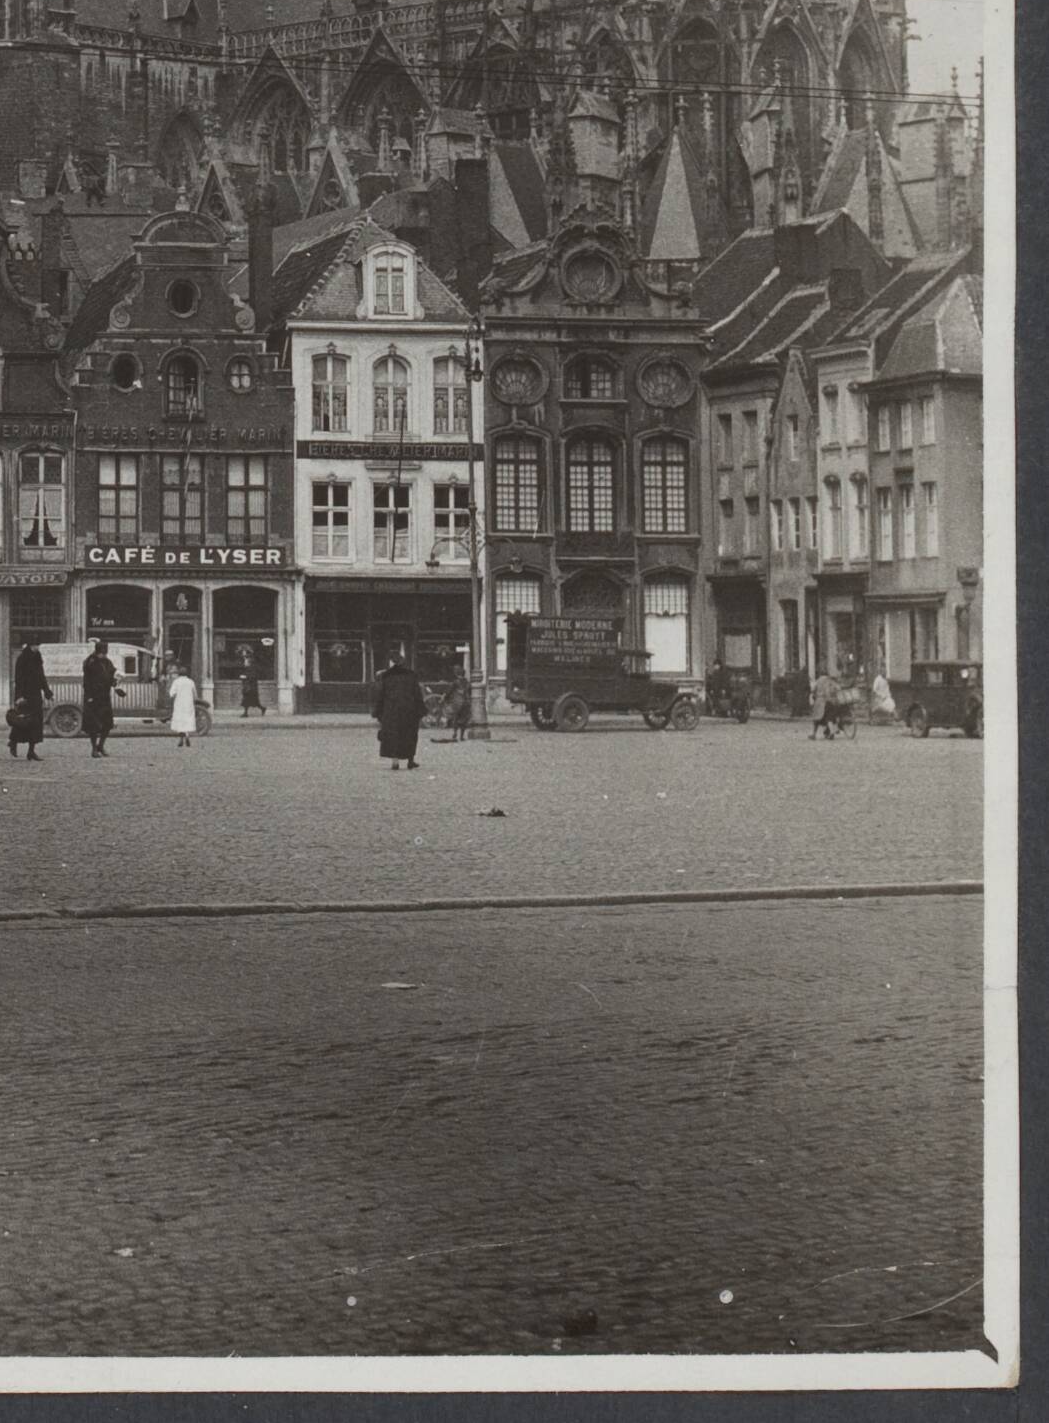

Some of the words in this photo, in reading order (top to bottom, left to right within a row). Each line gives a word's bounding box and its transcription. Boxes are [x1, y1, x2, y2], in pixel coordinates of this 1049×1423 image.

[26, 423, 73, 438] MARIN
[239, 426, 282, 443] MARIN
[88, 545, 156, 564] CAFÉ
[164, 551, 191, 564] DE
[199, 548, 282, 566] L'YSER
[575, 620, 614, 631] MODERNE
[541, 629, 569, 640] JULES
